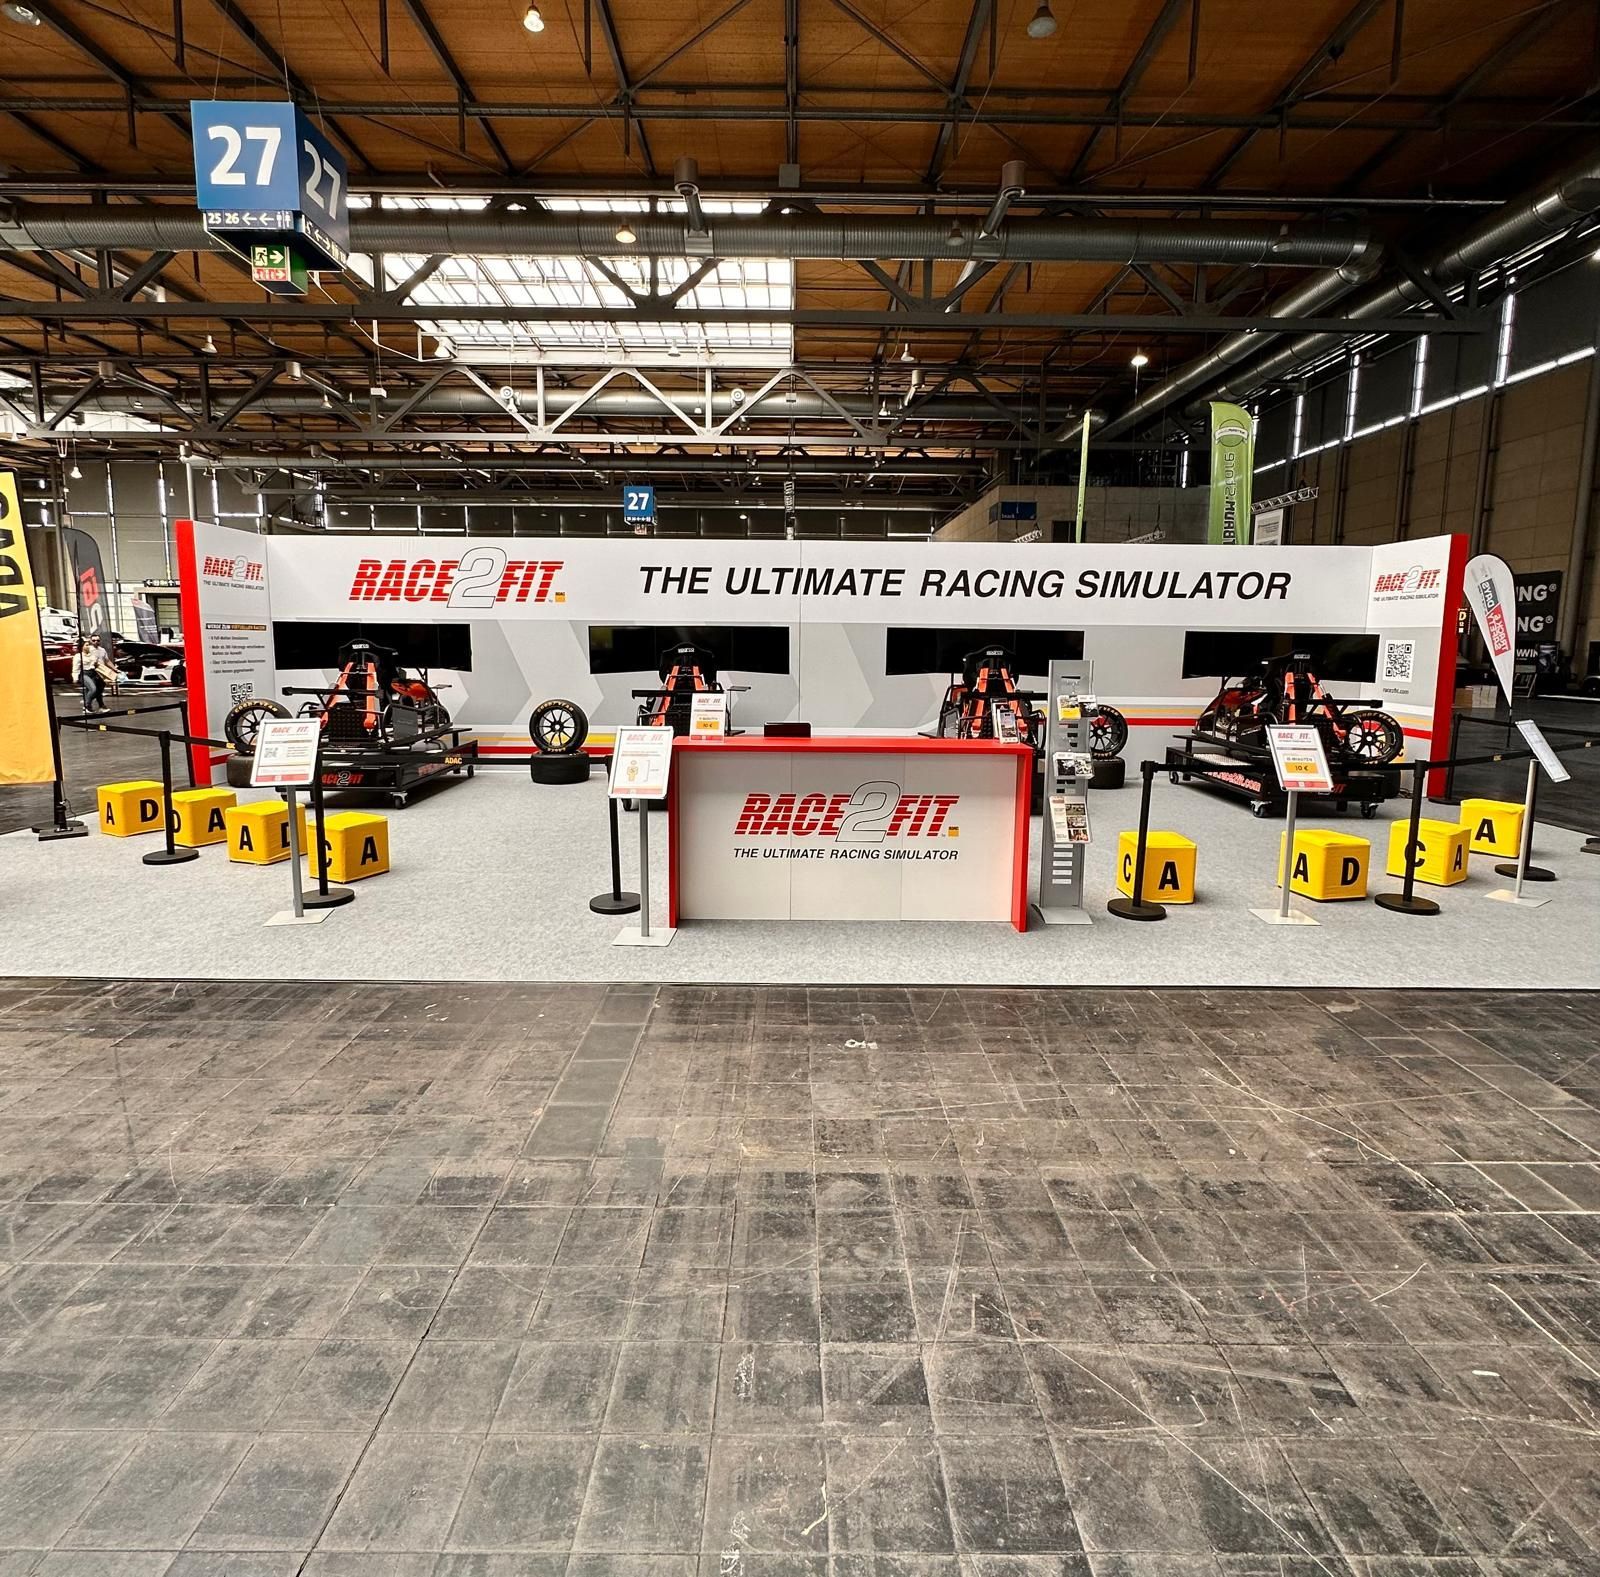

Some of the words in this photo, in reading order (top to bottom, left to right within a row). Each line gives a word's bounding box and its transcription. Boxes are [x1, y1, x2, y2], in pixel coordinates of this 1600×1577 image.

[207, 125, 281, 186] 27
[303, 139, 341, 221] 27
[208, 213, 221, 224] 25
[225, 213, 239, 224] 26
[627, 492, 649, 510] 27
[348, 546, 565, 608] RACE2FIT
[639, 566, 712, 594] THE
[725, 567, 905, 597] ULTIMATE
[920, 569, 1064, 598] RACING
[1075, 570, 1292, 600] SIMULATOR
[445, 757, 462, 765] ADAC
[106, 801, 115, 826] A
[139, 798, 159, 823] D
[207, 807, 226, 832] A
[734, 780, 960, 843] RACE2FIT
[239, 825, 254, 852] A
[1474, 818, 1496, 844] A
[360, 836, 379, 866] A
[734, 848, 759, 858] THE
[763, 848, 825, 859] ULTIMATE
[830, 849, 880, 860] RACING
[883, 850, 959, 860] SIMULATOR
[1453, 844, 1463, 872] A
[1122, 853, 1132, 883] C
[1158, 861, 1180, 890] A
[1292, 852, 1309, 883] A
[1340, 856, 1360, 886] D
